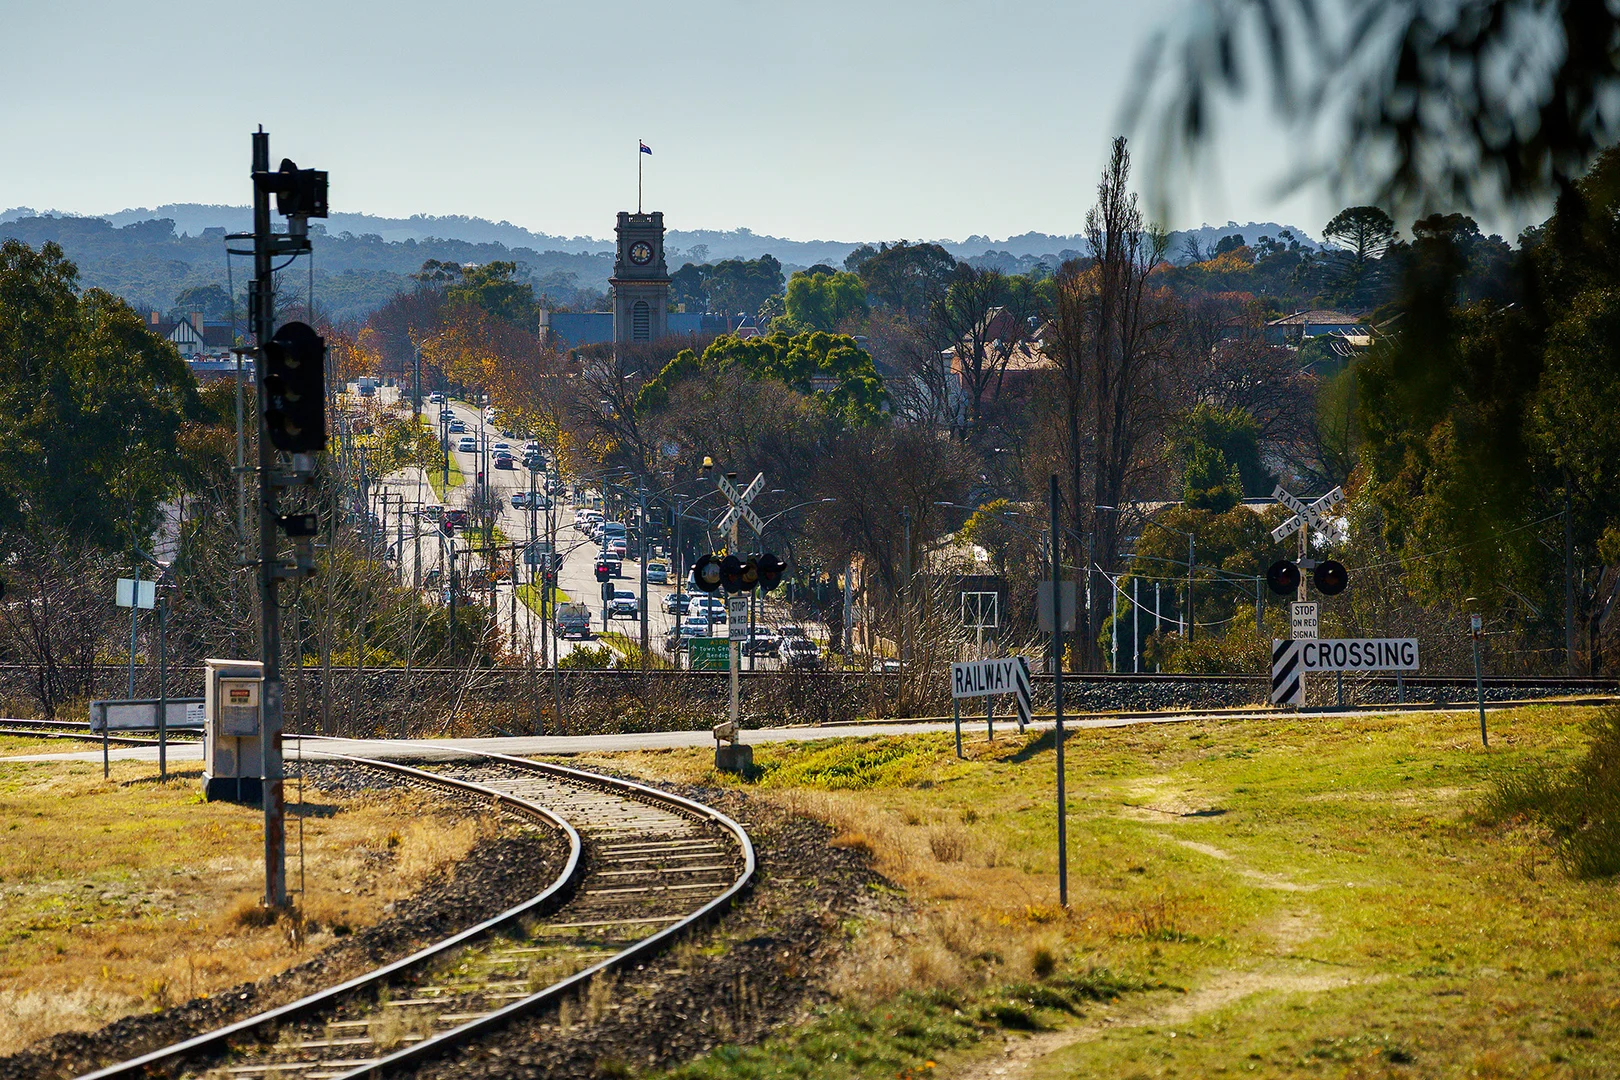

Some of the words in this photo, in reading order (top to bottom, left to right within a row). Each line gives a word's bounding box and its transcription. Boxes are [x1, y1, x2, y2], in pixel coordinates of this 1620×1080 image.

[1277, 491, 1340, 539] CROSSING
[731, 601, 746, 612] STOP
[1294, 605, 1315, 616] STOP
[730, 616, 737, 624] ON
[1292, 619, 1303, 628] ON
[1303, 618, 1317, 628] RED
[1293, 630, 1318, 639] SIGNAL
[1303, 642, 1414, 668] CROSSING
[955, 662, 1013, 693] RAILWAY
